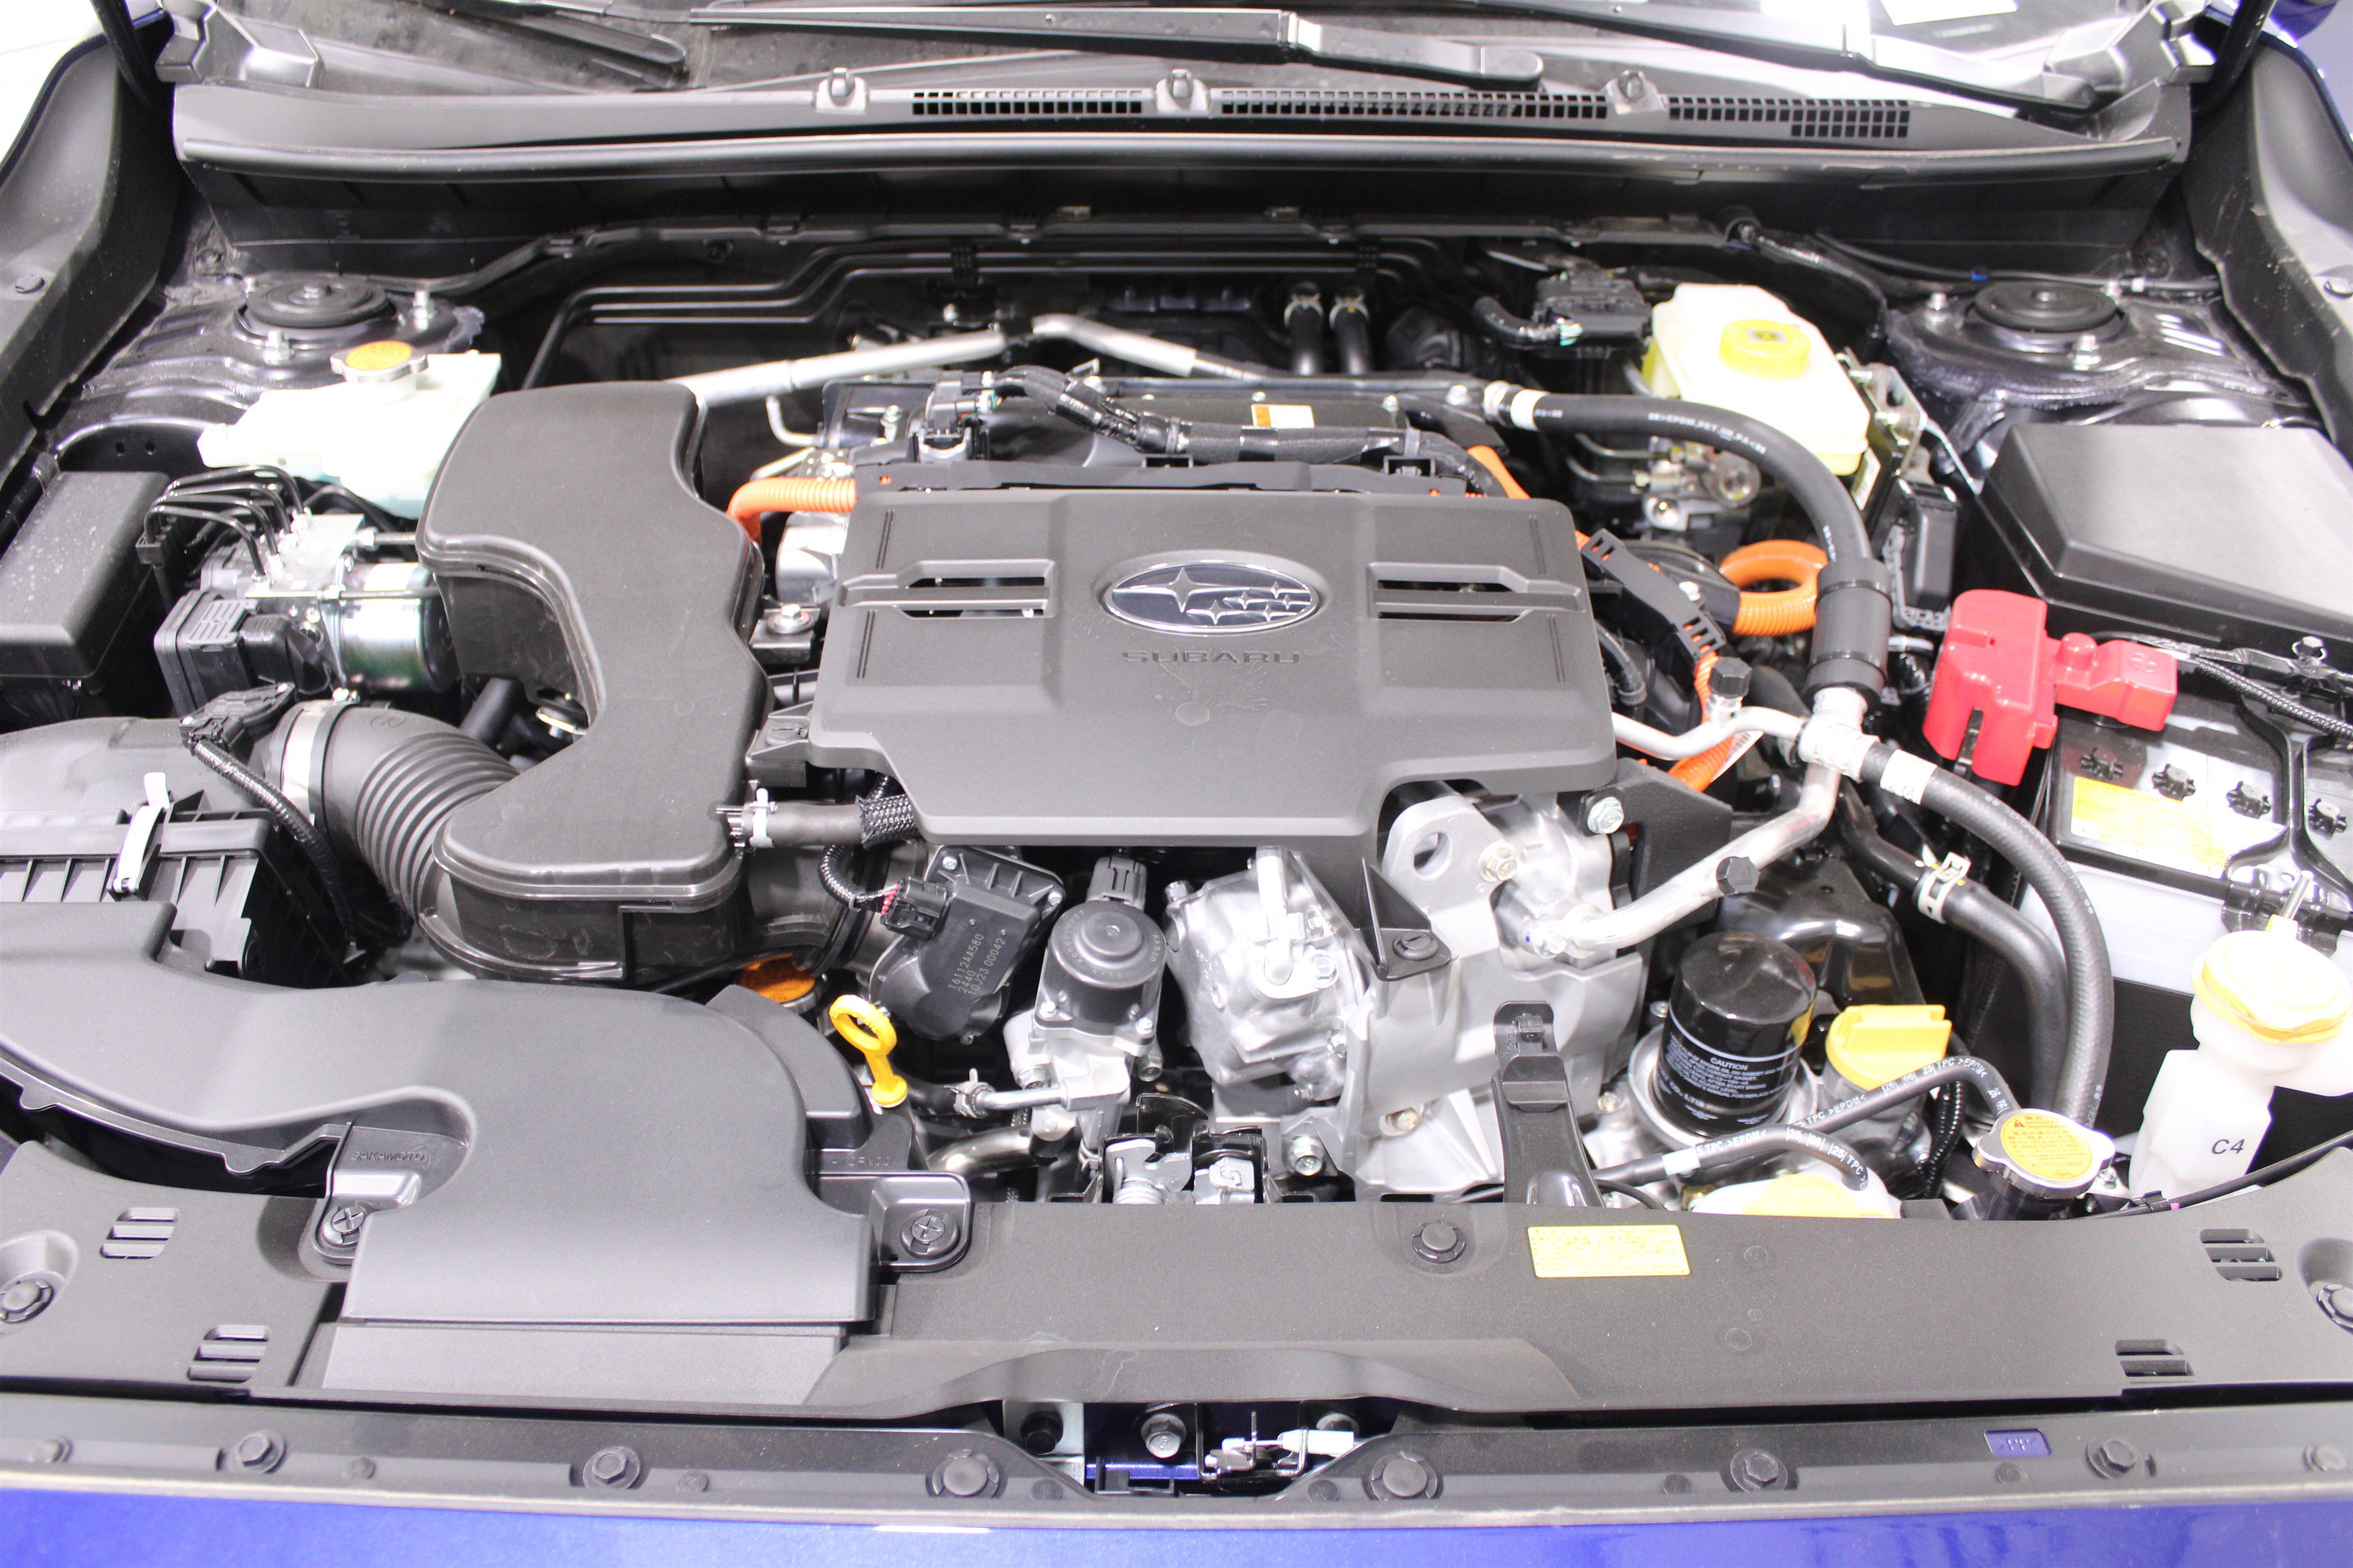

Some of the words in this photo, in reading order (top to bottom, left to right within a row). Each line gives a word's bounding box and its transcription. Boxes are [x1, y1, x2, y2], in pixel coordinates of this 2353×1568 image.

[1121, 650, 1300, 664] SUBARU
[948, 933, 984, 990] 16112AA580
[968, 967, 989, 995] 10J23
[983, 938, 1006, 967] 00042
[958, 970, 976, 994] 2440
[1710, 1057, 1749, 1071] CAUTION
[1806, 1111, 1826, 1126] TPC
[1937, 1057, 1955, 1069] TPC
[351, 1151, 425, 1161] SAKAMOTO
[1706, 1141, 1724, 1153] TPC
[1846, 1154, 1864, 1176] TPC
[2211, 1138, 2246, 1155] C4
